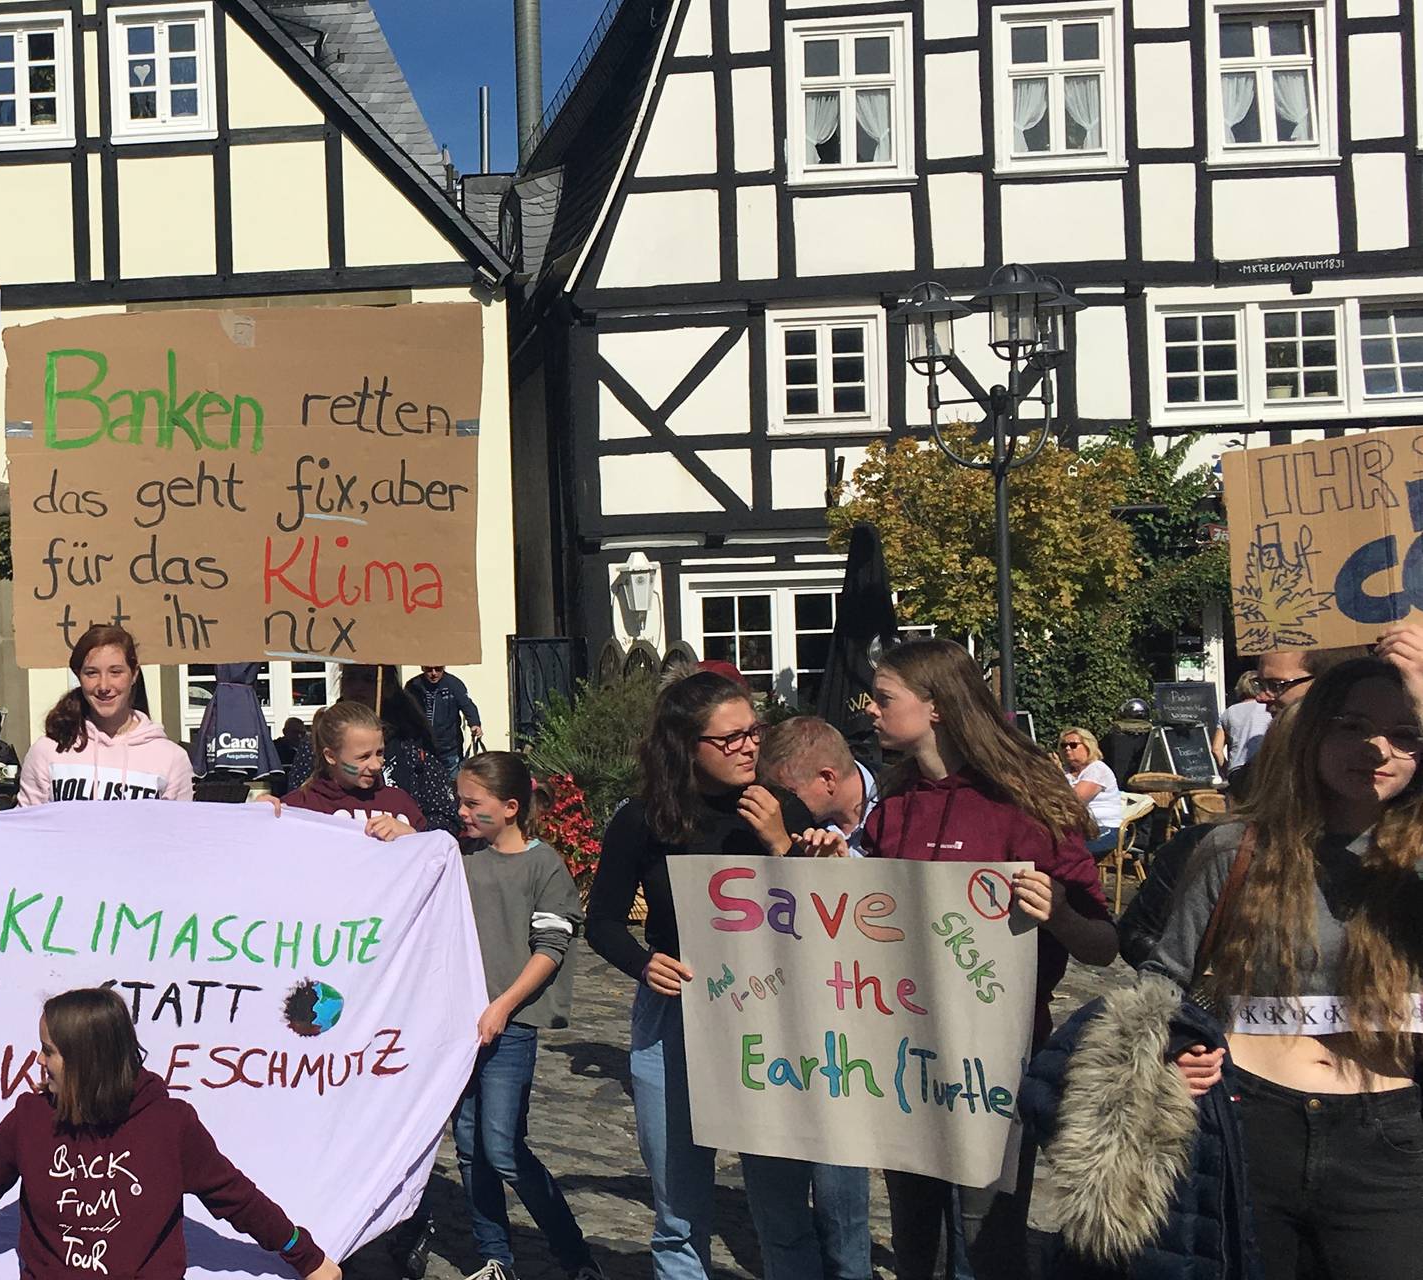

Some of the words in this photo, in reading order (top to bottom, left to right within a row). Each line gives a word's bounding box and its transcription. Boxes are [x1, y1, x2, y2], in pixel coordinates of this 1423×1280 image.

[44, 348, 264, 454] Banken
[302, 376, 450, 437] retten
[33, 468, 108, 517] das
[134, 461, 246, 528] geht
[1257, 439, 1400, 519] IHR
[34, 538, 113, 600] für
[129, 535, 229, 590] das
[264, 536, 444, 614] Klima
[57, 592, 131, 650] tt
[165, 593, 218, 651] ihr
[264, 607, 357, 655] nix
[0, 888, 383, 969] KLIMASCHUTZ
[708, 867, 906, 943] Save
[99, 979, 263, 1027] TATT
[707, 963, 735, 1001] And
[826, 960, 929, 1016] the
[741, 1031, 885, 1099] Earth
[49, 1144, 139, 1181] BACK
